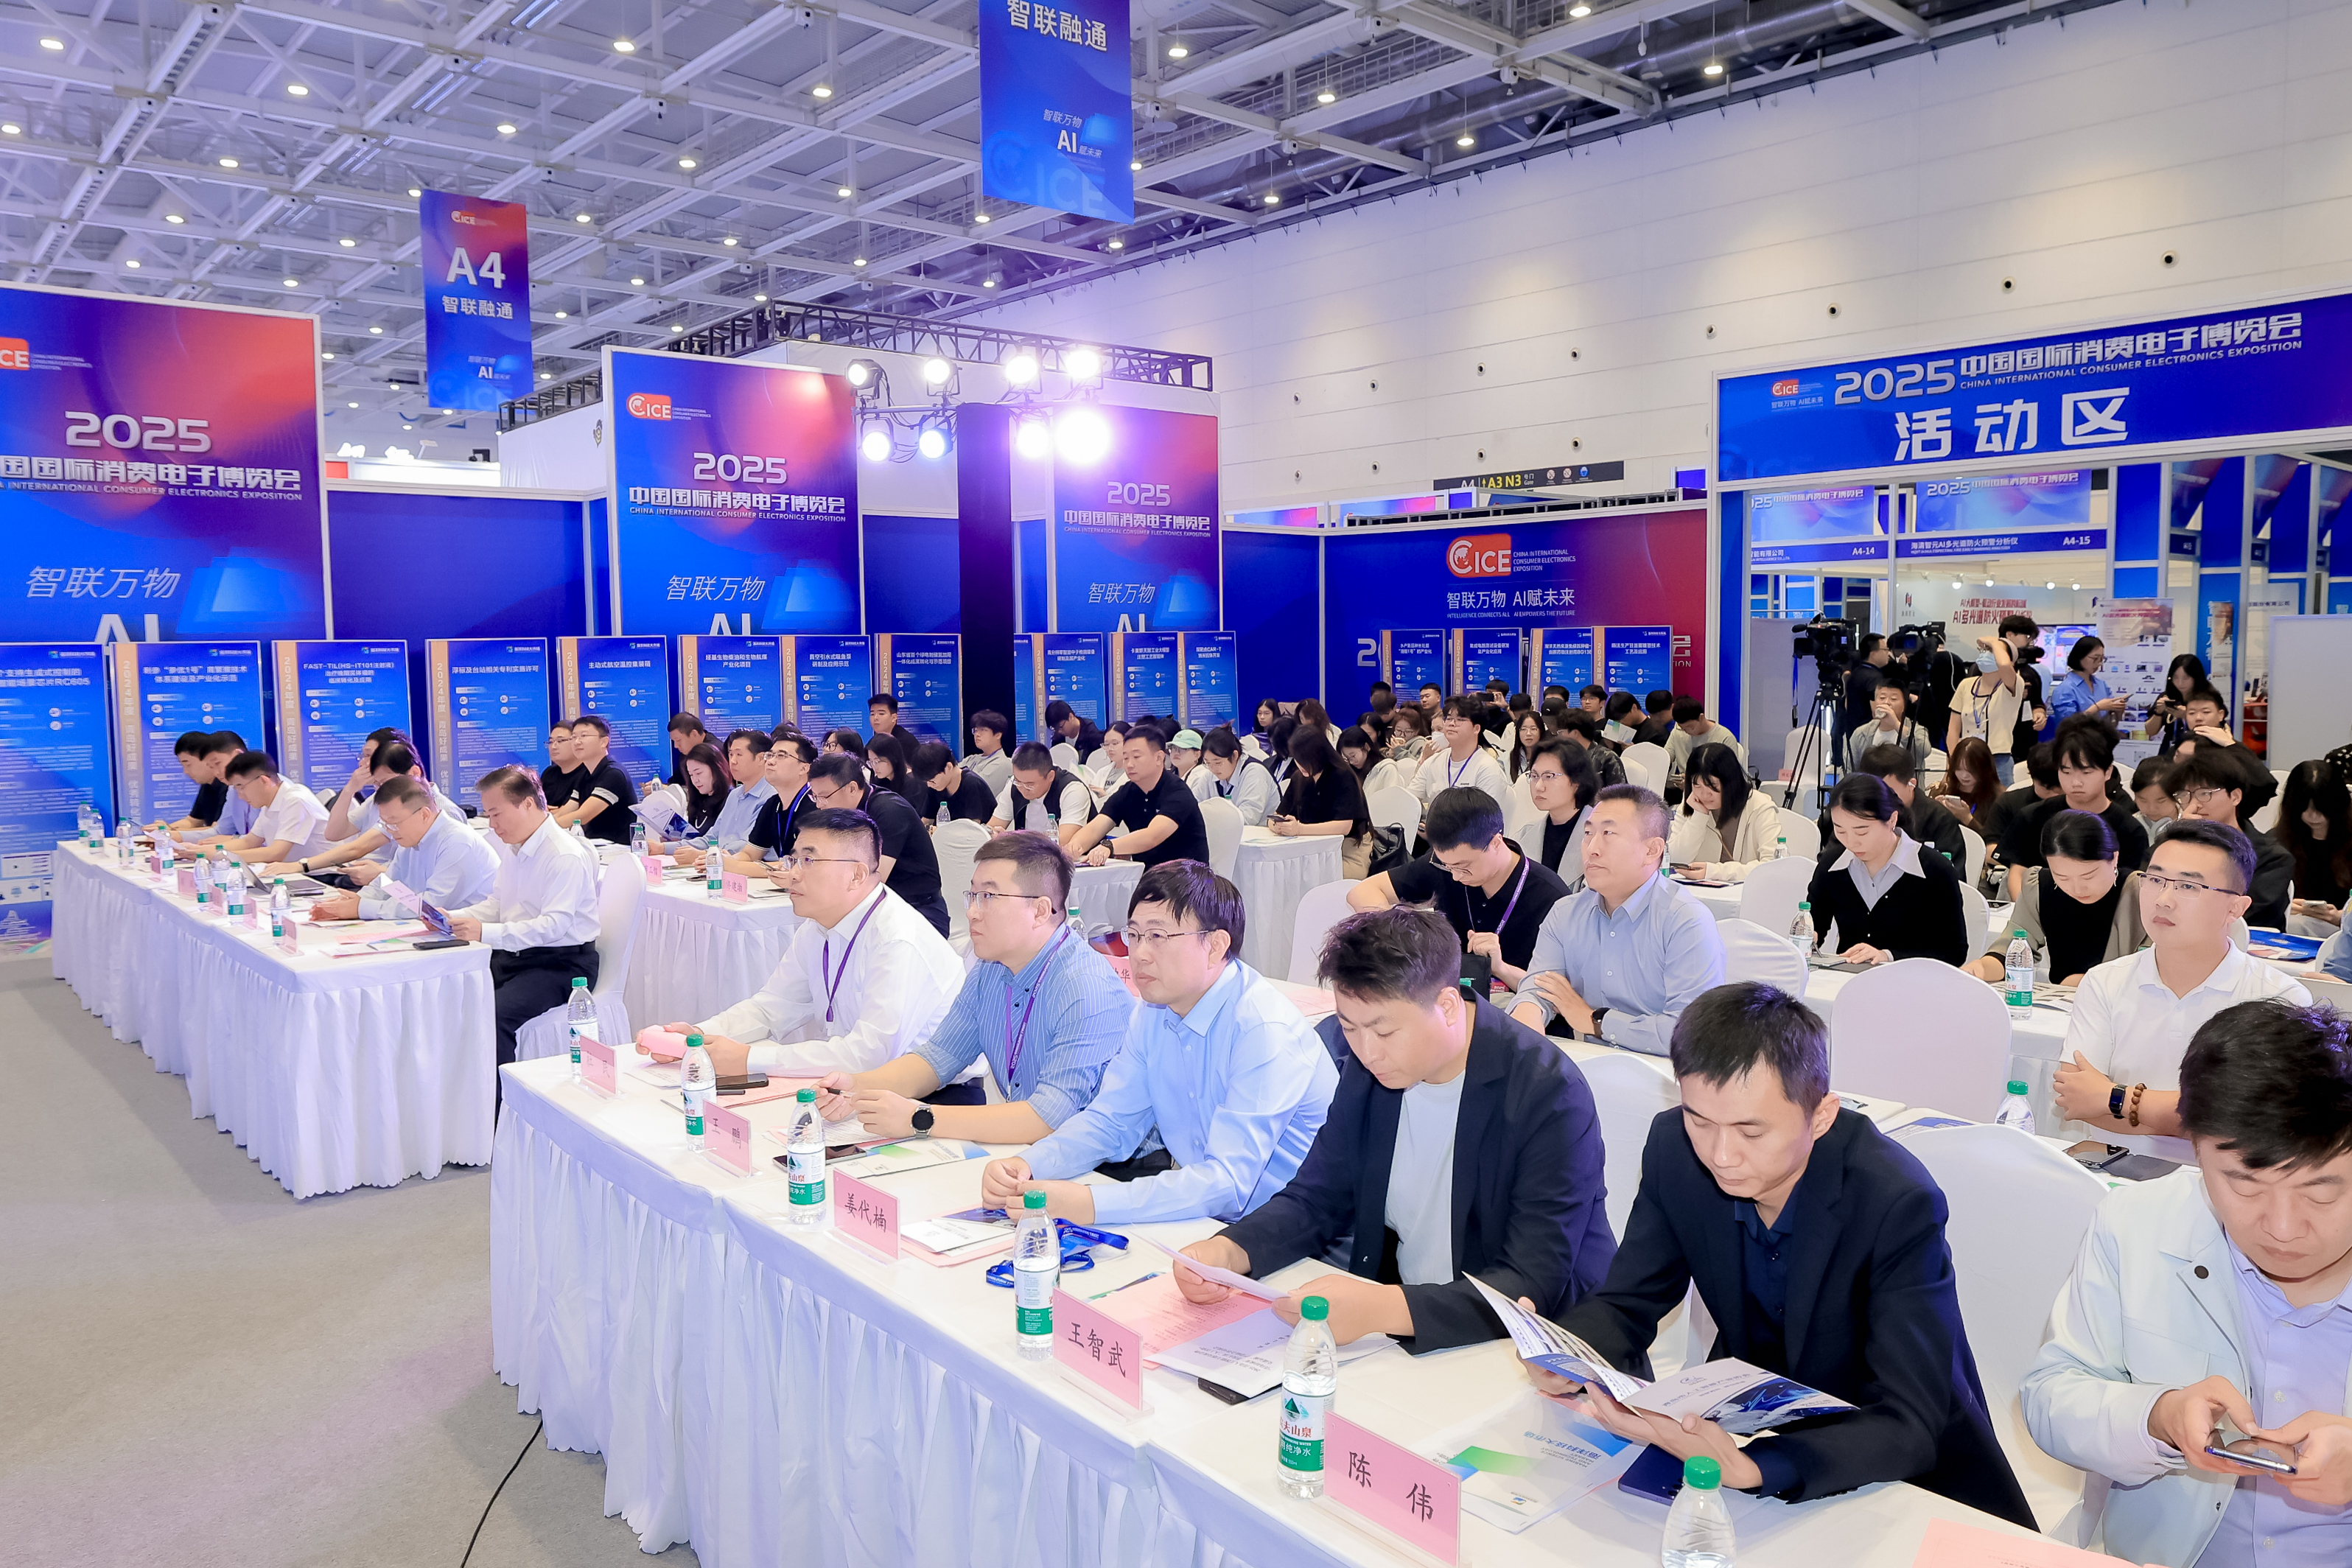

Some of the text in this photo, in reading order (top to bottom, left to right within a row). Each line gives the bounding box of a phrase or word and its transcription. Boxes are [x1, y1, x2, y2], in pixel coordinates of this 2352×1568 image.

[1007, 0, 1107, 52] 智联融通
[1043, 108, 1082, 129] 智联万物
[1057, 129, 1103, 159] AI 赋未来
[446, 246, 506, 290] A4
[442, 295, 514, 320] 智联融通
[478, 365, 494, 379] AI
[1835, 312, 2303, 406] 2025 中国国际消费电子博览会
[1960, 340, 2303, 390] CHINA INTERNATIONAL CONSUMER ELECTRONICS EXPOSITION
[628, 394, 671, 419] CICE
[65, 410, 212, 452] 2025
[1894, 387, 2130, 462] 活动区
[693, 452, 788, 485] 2025
[1487, 477, 1503, 489] A3
[1505, 474, 1522, 487] N3
[7, 481, 303, 501] INTERNATIONAL CONSUMER ELECTRONICS EXPOSITION
[1107, 481, 1171, 507] 2025
[1774, 489, 1864, 503] 中国国际消费电子博览会
[1927, 472, 2079, 497] 2025 中国国际消费电子博览会
[629, 486, 845, 514] 中国国际消费电子博览会
[657, 508, 715, 517] INTERNATIONAL
[717, 511, 757, 519] CONSUMER
[759, 512, 805, 520] ELECTRONICS
[807, 514, 846, 522] EXPOSITION
[1064, 510, 1211, 531] 中国国际消费电子博览会
[1529, 549, 1569, 557] INTERNATIONAL
[1852, 547, 1875, 556] A4-14
[2062, 536, 2091, 545] A4-15
[1449, 539, 1511, 575] CICE
[26, 565, 181, 598] 智联万物
[665, 574, 766, 602] 智联万物
[1088, 582, 1155, 604] 智联万物
[1446, 587, 1575, 609] 智联万物 AI赋未来
[94, 613, 161, 643] AI
[708, 612, 751, 635] AI
[567, 652, 575, 699] 2024年度
[844, 1192, 887, 1233] 姜代楠
[1068, 1322, 1127, 1378] 王智武
[1523, 1431, 1602, 1460] 海洋科技大市场
[1348, 1450, 1435, 1524] 陈伟
